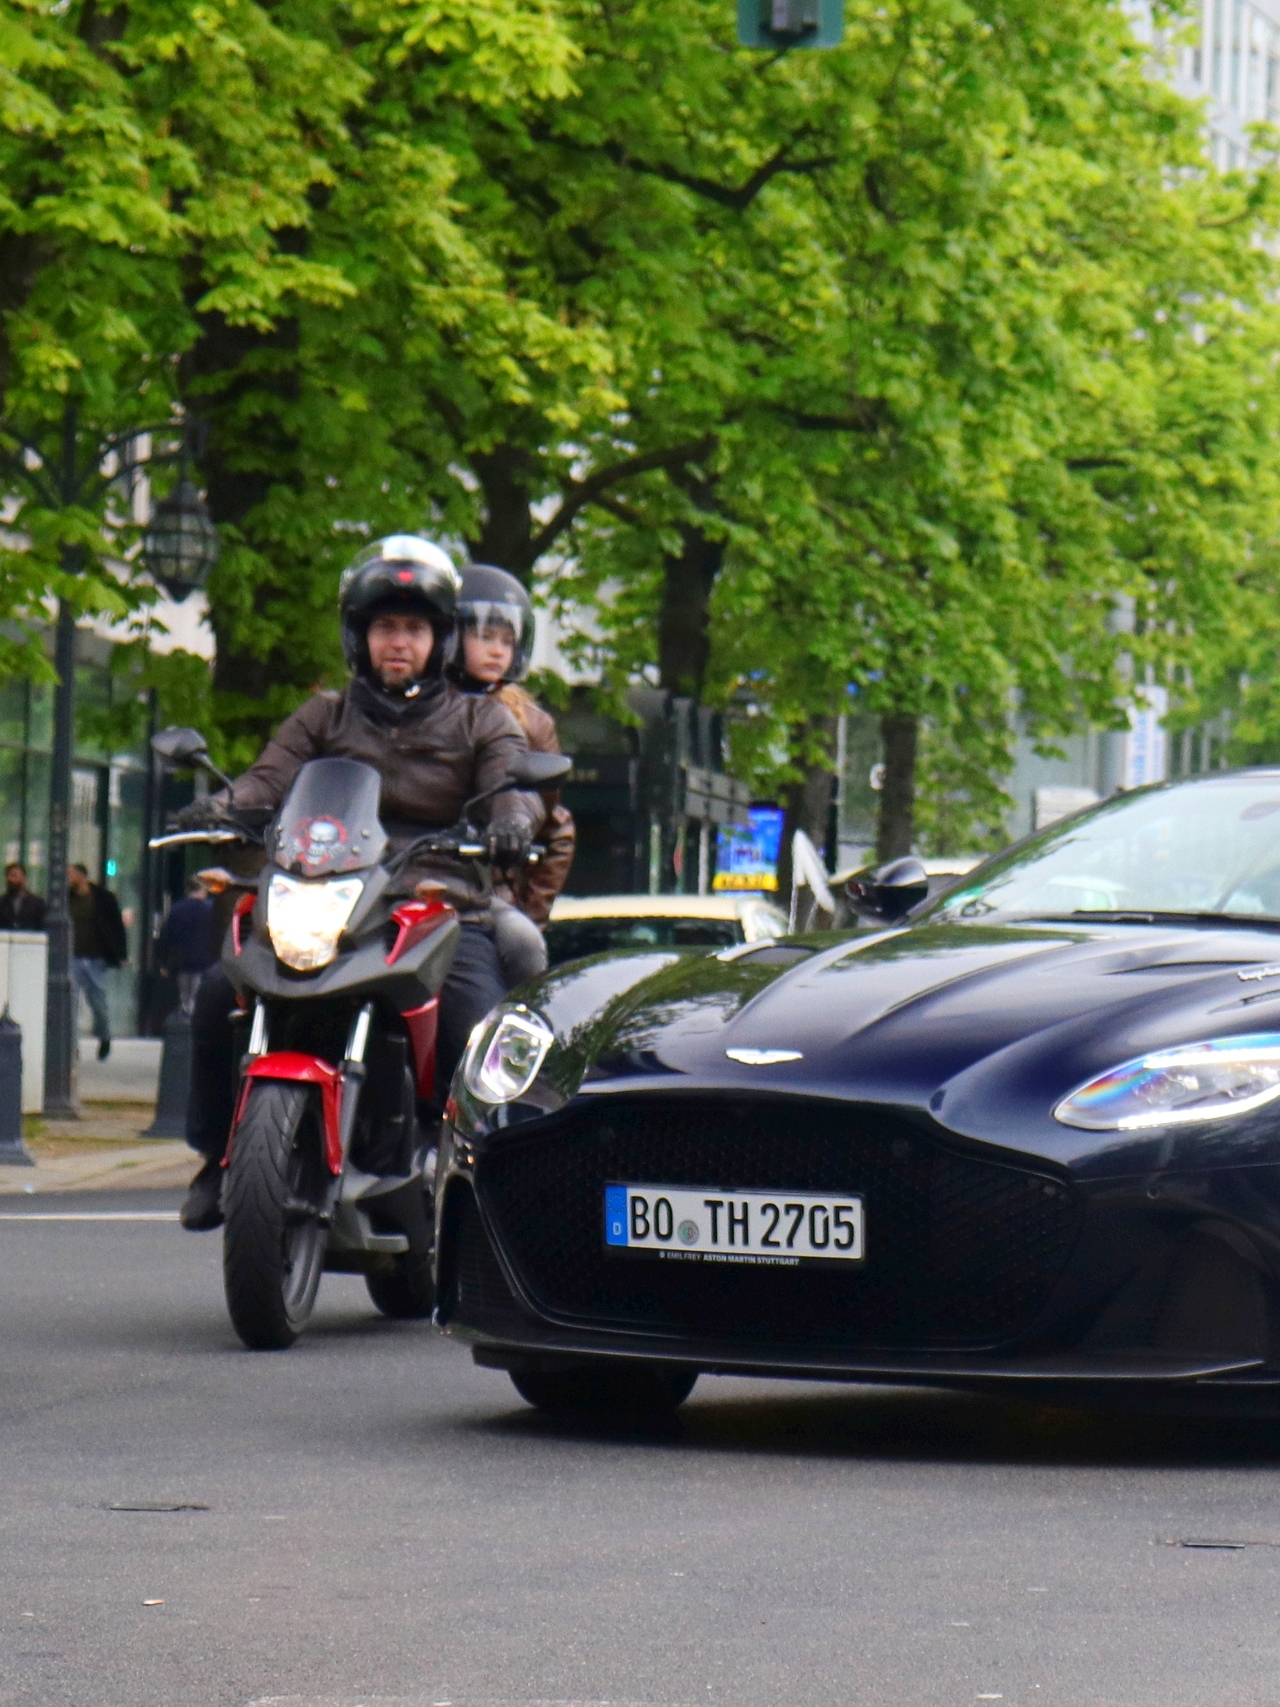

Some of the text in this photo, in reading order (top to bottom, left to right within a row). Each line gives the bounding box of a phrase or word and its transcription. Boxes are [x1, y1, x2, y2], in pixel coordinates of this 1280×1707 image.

[612, 1221, 621, 1236] D
[630, 1195, 855, 1250] BO TH 2705
[703, 1254, 727, 1262] ASTON
[727, 1255, 756, 1264] MARTIN
[757, 1257, 800, 1266] STUTTGART
